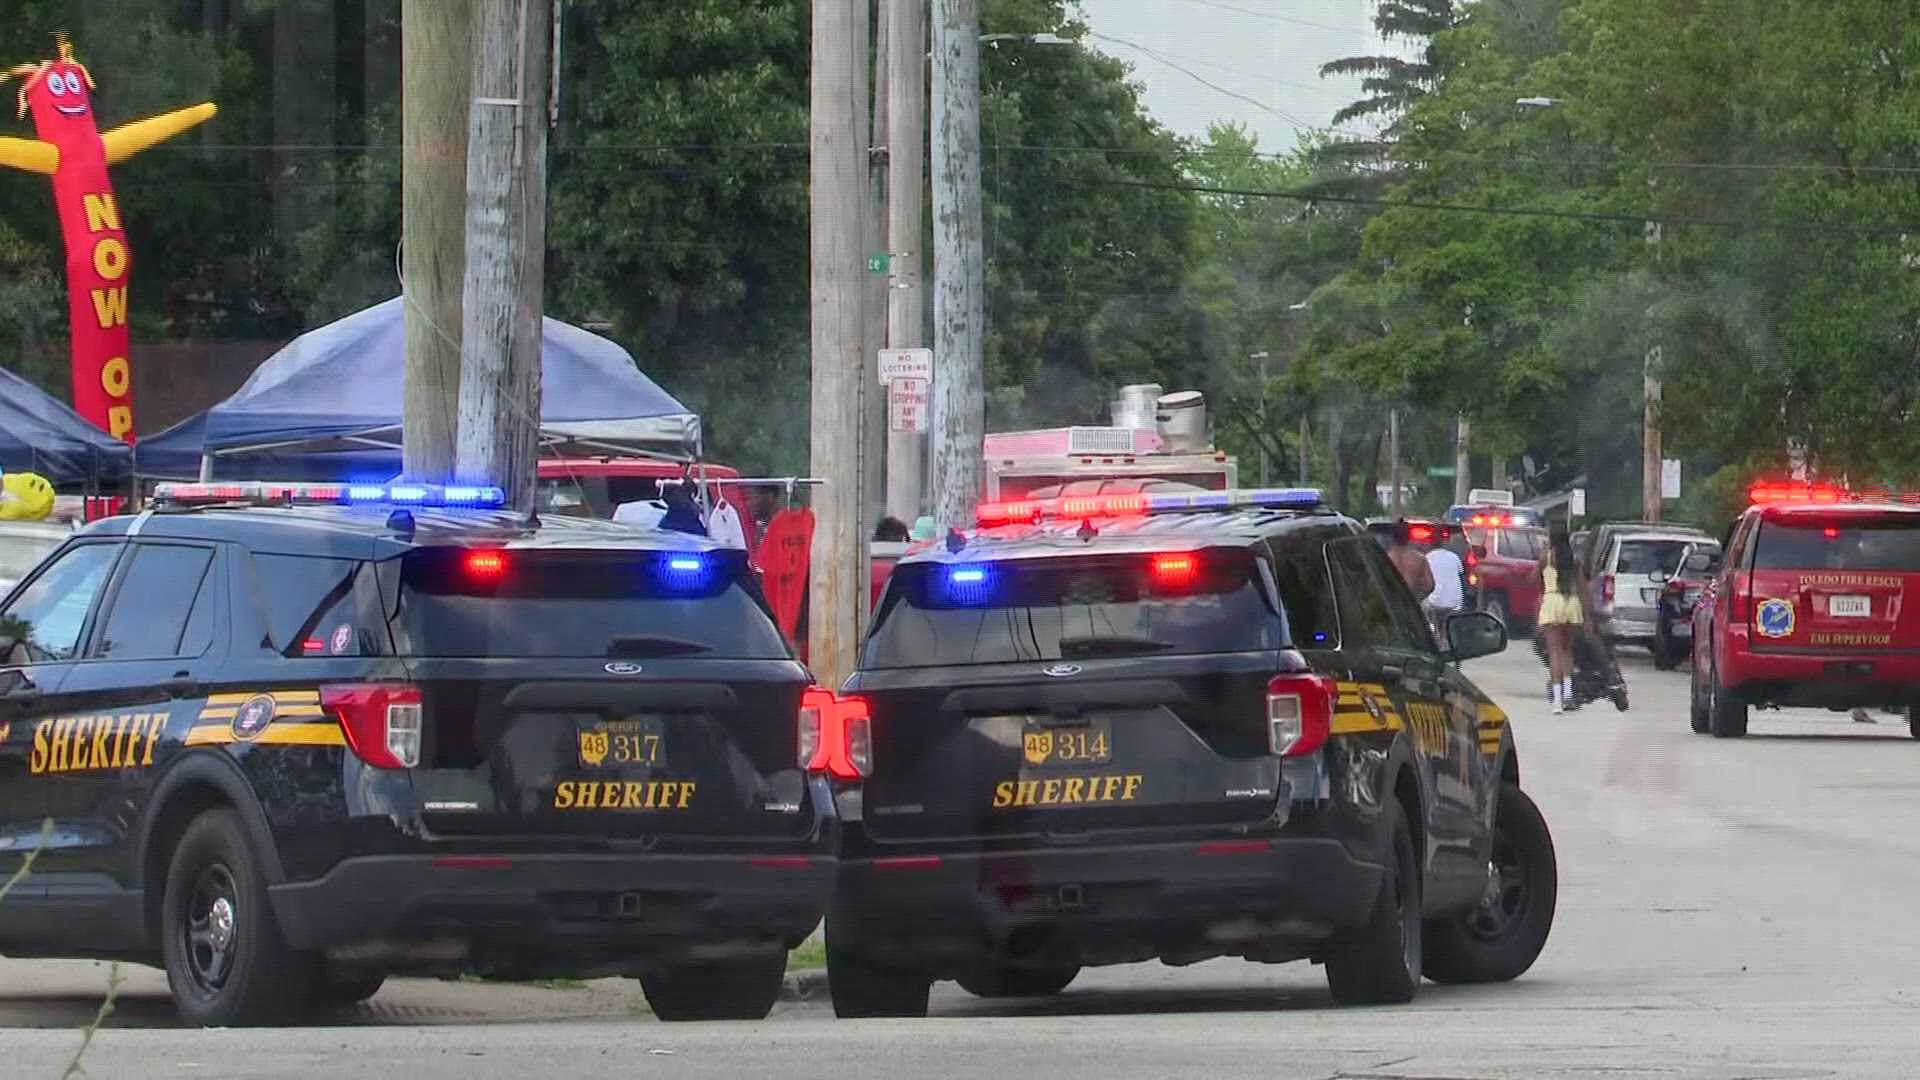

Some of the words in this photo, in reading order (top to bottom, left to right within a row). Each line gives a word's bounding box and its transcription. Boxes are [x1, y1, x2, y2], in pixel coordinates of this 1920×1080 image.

[83, 193, 128, 329] NOW
[898, 354, 912, 362] NO
[883, 364, 928, 373] LOITERING
[903, 381, 916, 391] NO
[894, 393, 927, 405] STOPPING
[902, 407, 916, 417] ANY
[1800, 575, 1839, 585] TOLEDO
[1841, 575, 1864, 586] FIRE
[1865, 576, 1904, 588] RESCUE
[1832, 633, 1891, 645] SUPERVISOR
[31, 712, 170, 775] SHERIFF
[583, 736, 607, 756] 48
[614, 735, 660, 763] 317
[1027, 735, 1050, 753] 48
[1058, 731, 1108, 760] 314
[554, 781, 696, 808] SHERIFF
[992, 775, 1144, 808] SHERIFF
